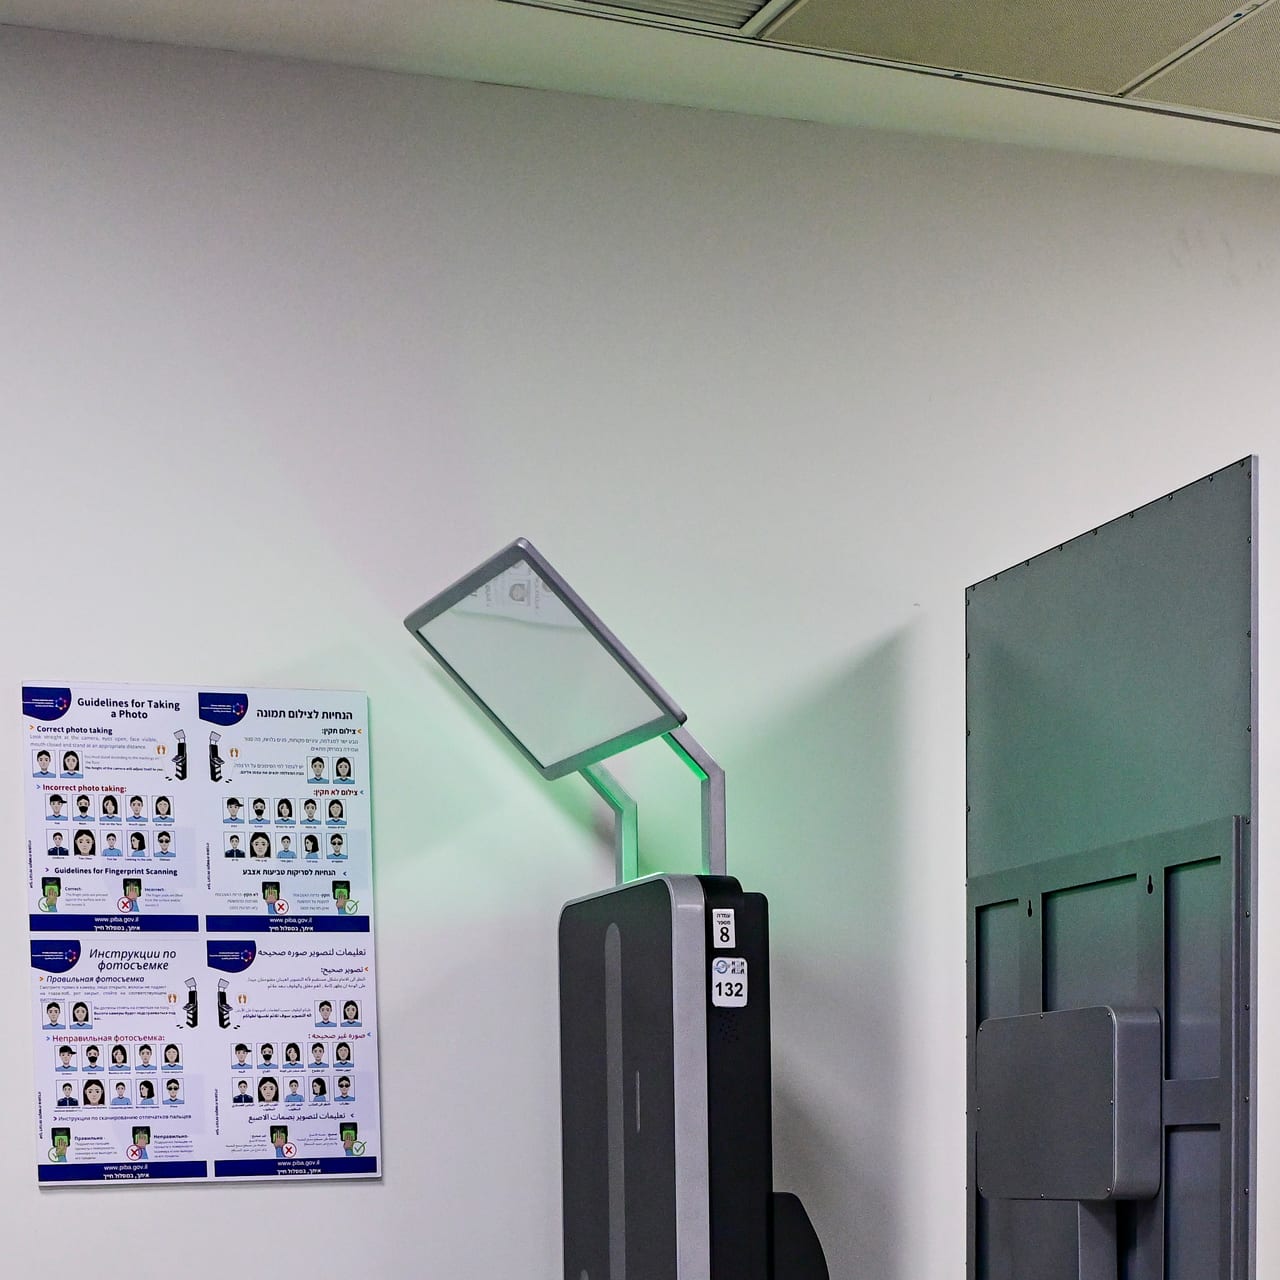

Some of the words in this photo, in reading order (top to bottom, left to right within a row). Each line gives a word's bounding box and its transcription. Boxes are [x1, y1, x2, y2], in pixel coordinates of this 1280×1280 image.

[77, 697, 128, 708] Guidelines
[130, 698, 145, 707] for
[146, 699, 180, 711] Taking
[118, 709, 147, 718] Photo
[256, 709, 285, 718] תמונה
[288, 709, 319, 718] לצילום
[321, 711, 352, 719] הנחיות
[65, 726, 87, 734] photo
[88, 726, 112, 735] taking
[42, 783, 76, 791] Incorrect
[77, 784, 99, 792] photo
[340, 788, 357, 796] צילום
[104, 867, 144, 875] Fingerprint
[145, 868, 177, 876] Scanning
[286, 868, 313, 877] לסריקות
[720, 926, 730, 943] 8
[89, 948, 160, 961] Инструкции
[162, 950, 176, 958] по
[97, 960, 168, 972] фотосъемке
[46, 975, 93, 984] Правильная
[95, 975, 144, 984] фотосъемка
[715, 981, 744, 997] 132
[52, 1034, 112, 1043] Неправильная
